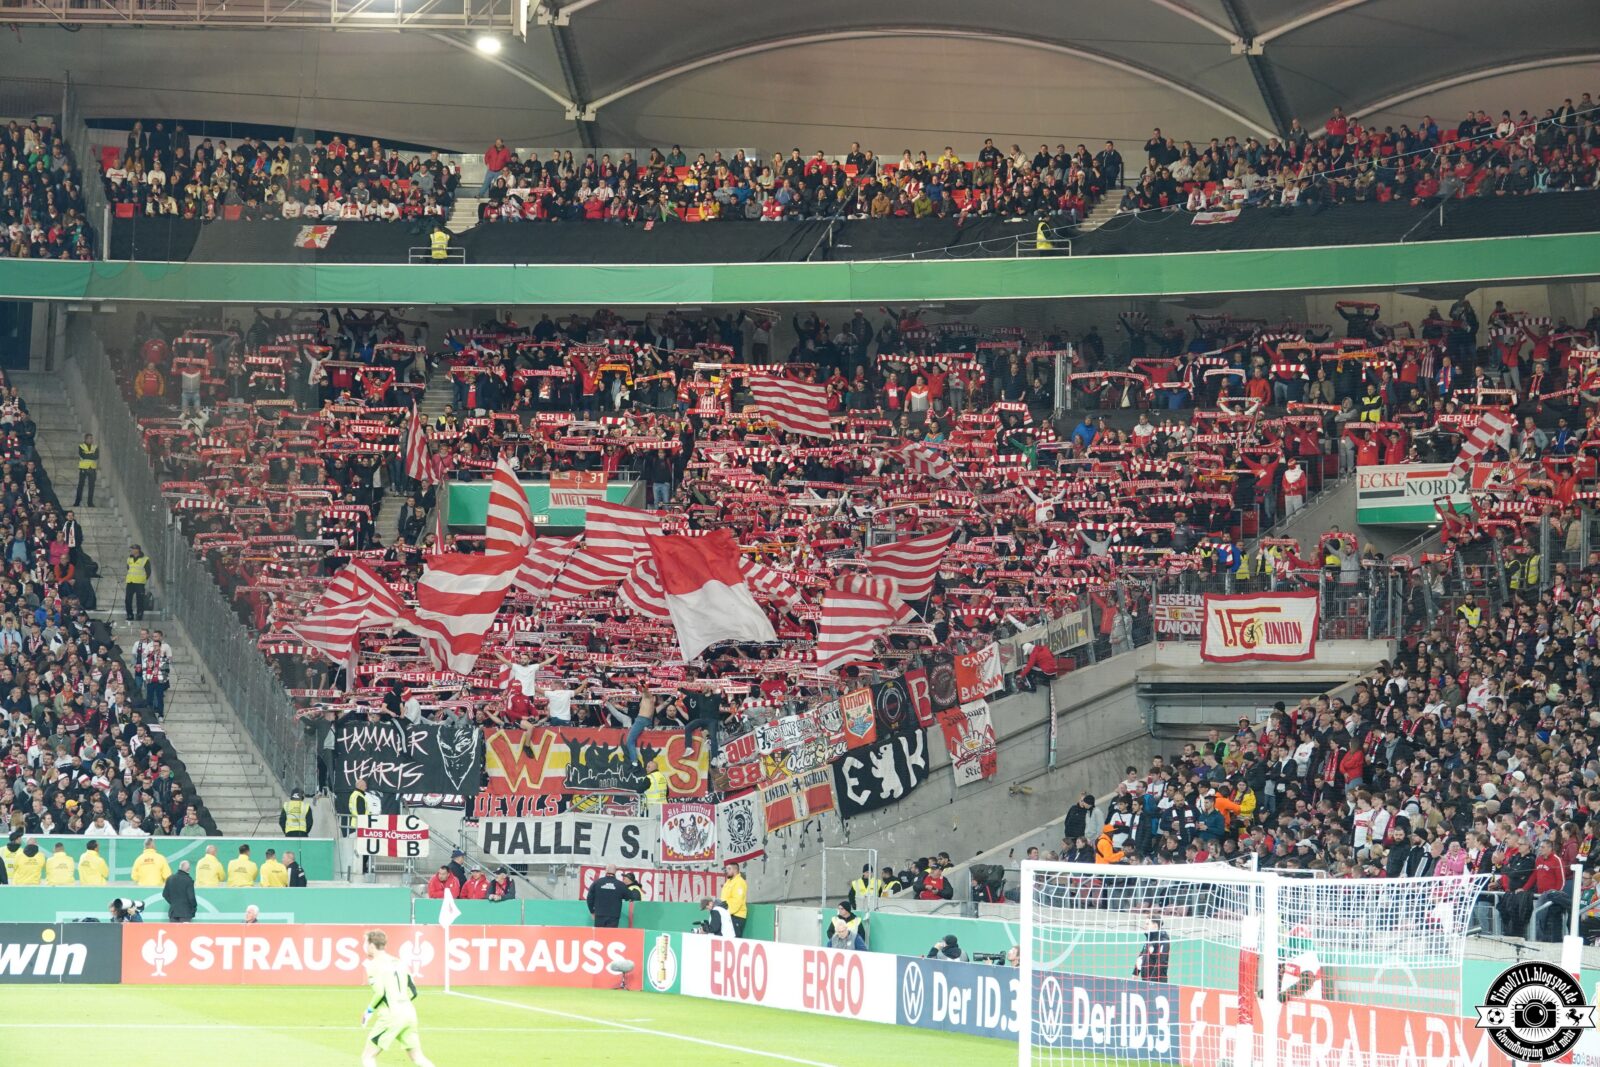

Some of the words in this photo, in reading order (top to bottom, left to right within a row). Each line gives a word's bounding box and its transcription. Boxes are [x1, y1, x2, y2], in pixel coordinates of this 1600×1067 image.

[589, 472, 604, 484] 31
[1359, 471, 1404, 489] ECKE
[1406, 479, 1457, 497] NORD
[1158, 621, 1201, 635] UNION
[1264, 621, 1302, 645] UNION
[344, 757, 425, 790] HEARTS
[487, 729, 557, 792] W
[667, 735, 703, 794] S
[474, 793, 562, 817] DEVILS
[384, 830, 422, 840] KÖPENICK
[405, 815, 420, 830] C
[366, 839, 380, 855] U
[406, 841, 420, 857] B
[483, 821, 593, 855] HALLE
[620, 825, 649, 860] S.
[189, 936, 371, 971] STRAUS
[447, 937, 627, 977] STRAUSS
[710, 939, 768, 1002] ERGO
[803, 949, 865, 1016] ERGO
[932, 971, 971, 1023] Der
[1072, 986, 1117, 1045] Der
[1120, 992, 1171, 1054] ID.3
